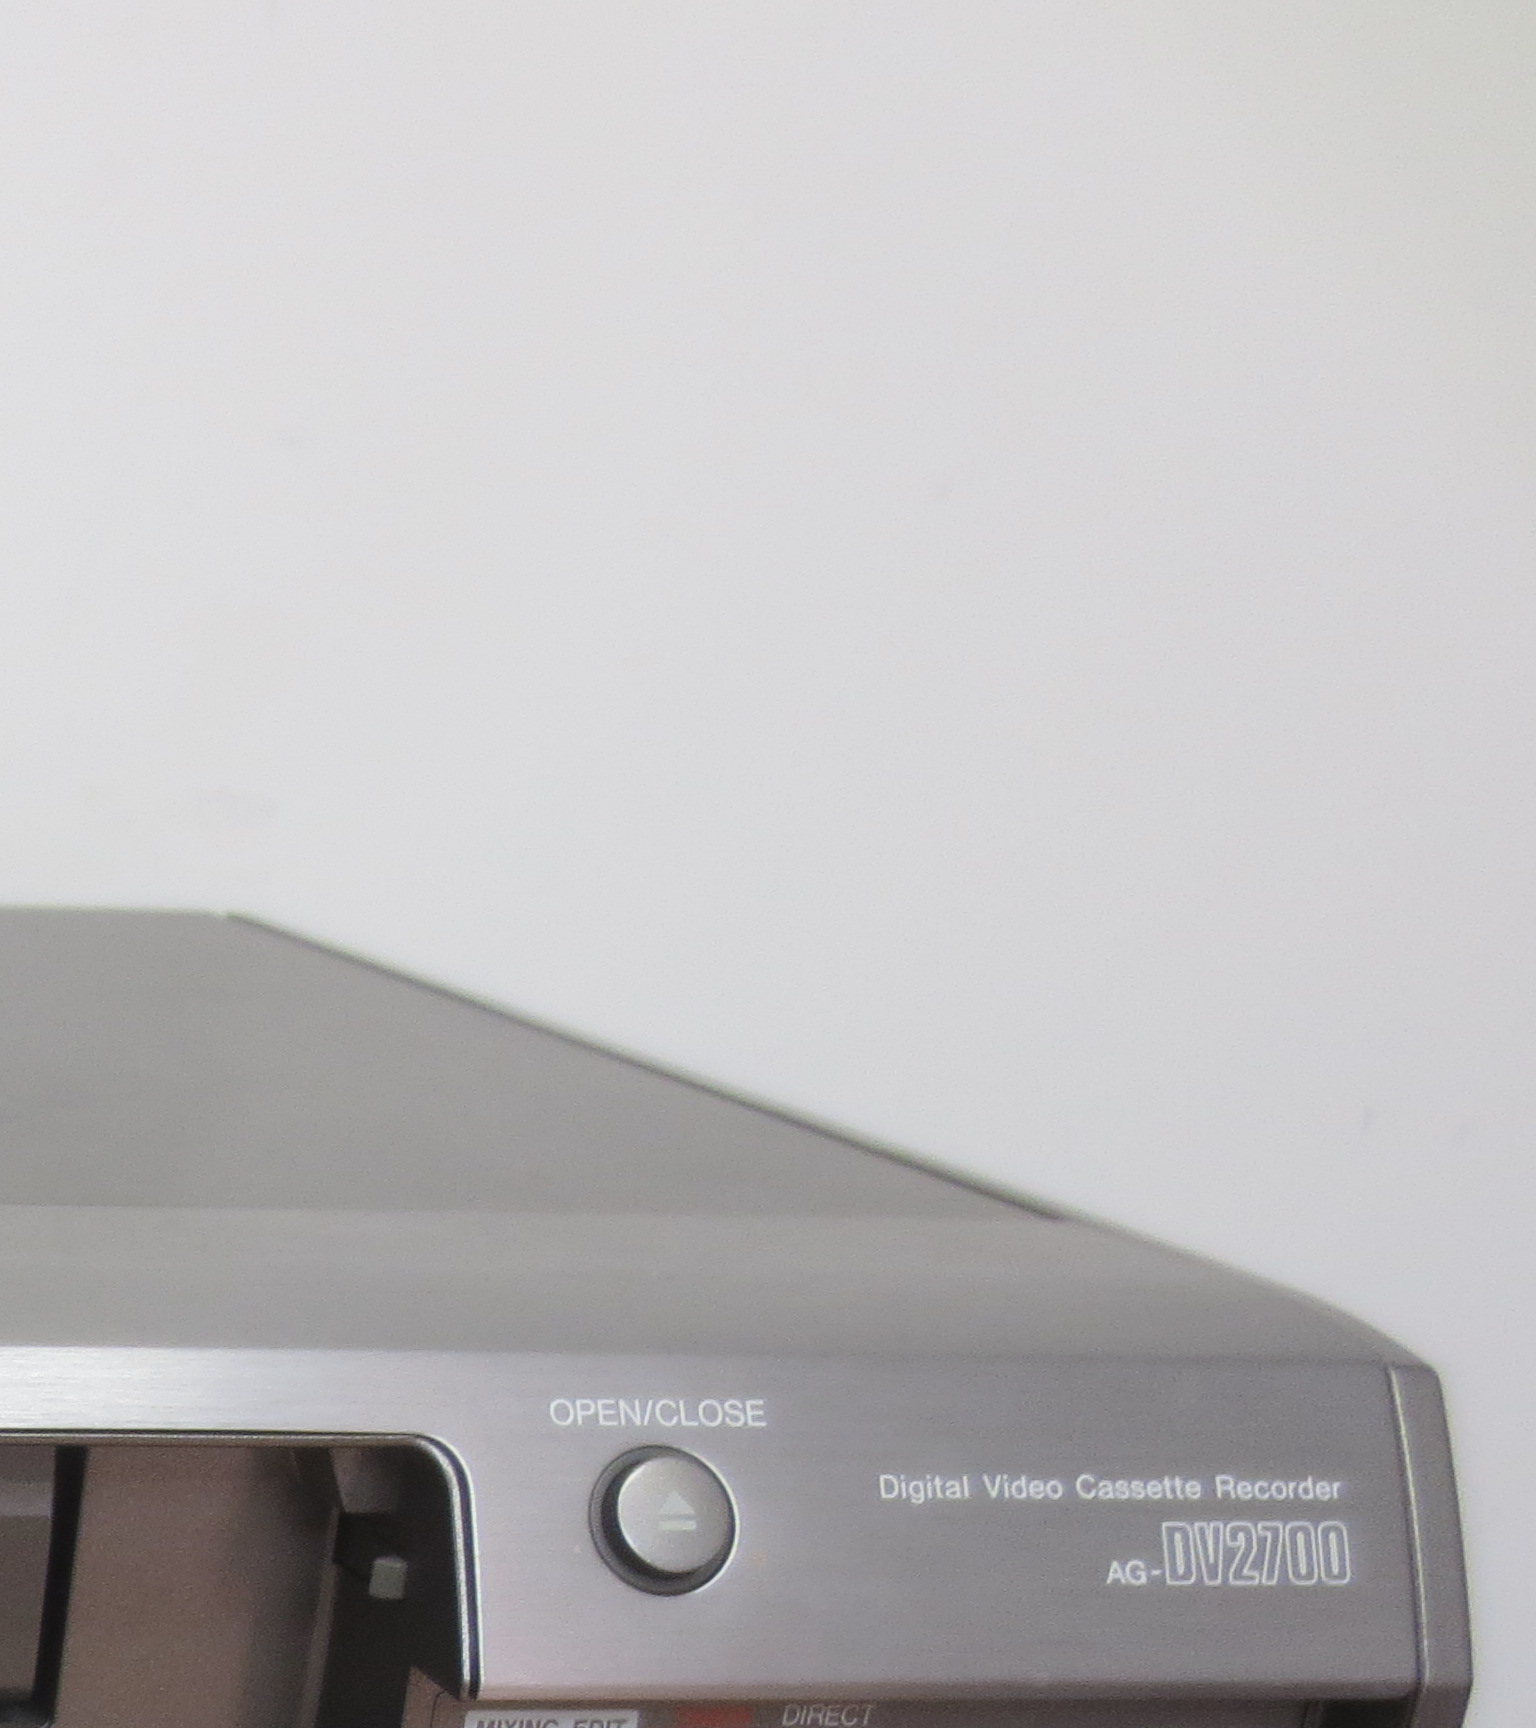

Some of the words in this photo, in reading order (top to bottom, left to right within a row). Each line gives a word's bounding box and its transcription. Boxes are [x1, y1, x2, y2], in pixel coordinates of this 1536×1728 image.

[549, 1399, 768, 1428] OPEN/CLOSE
[880, 1474, 970, 1505] Digital
[982, 1474, 1064, 1500] Video
[1075, 1474, 1202, 1500] Cassette
[1215, 1475, 1341, 1500] Recorder
[1106, 1521, 1351, 1586] AG-DV2700
[781, 1704, 876, 1727] DIRECT
